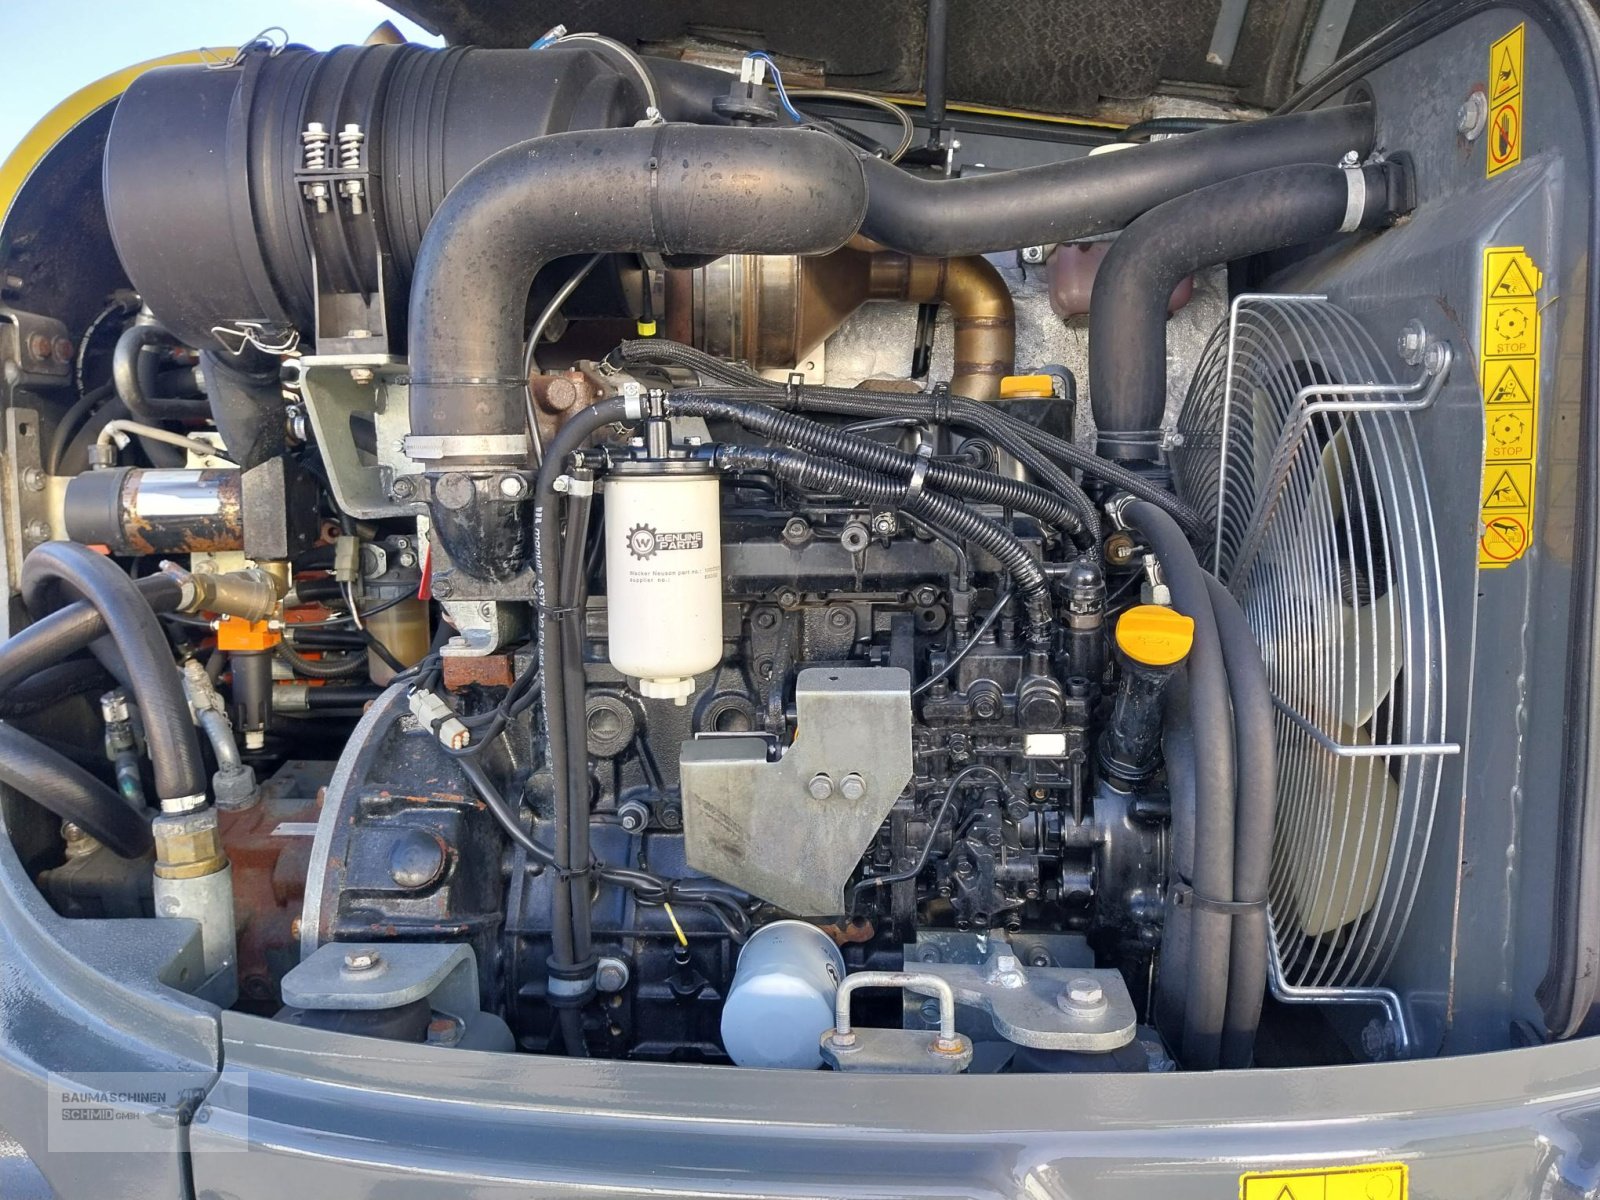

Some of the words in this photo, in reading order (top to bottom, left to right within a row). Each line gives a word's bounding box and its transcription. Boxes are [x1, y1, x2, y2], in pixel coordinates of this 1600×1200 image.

[1497, 343, 1527, 353] STOP
[1493, 446, 1523, 457] STOP
[655, 532, 702, 543] GENUINE
[659, 541, 699, 550] PARTS
